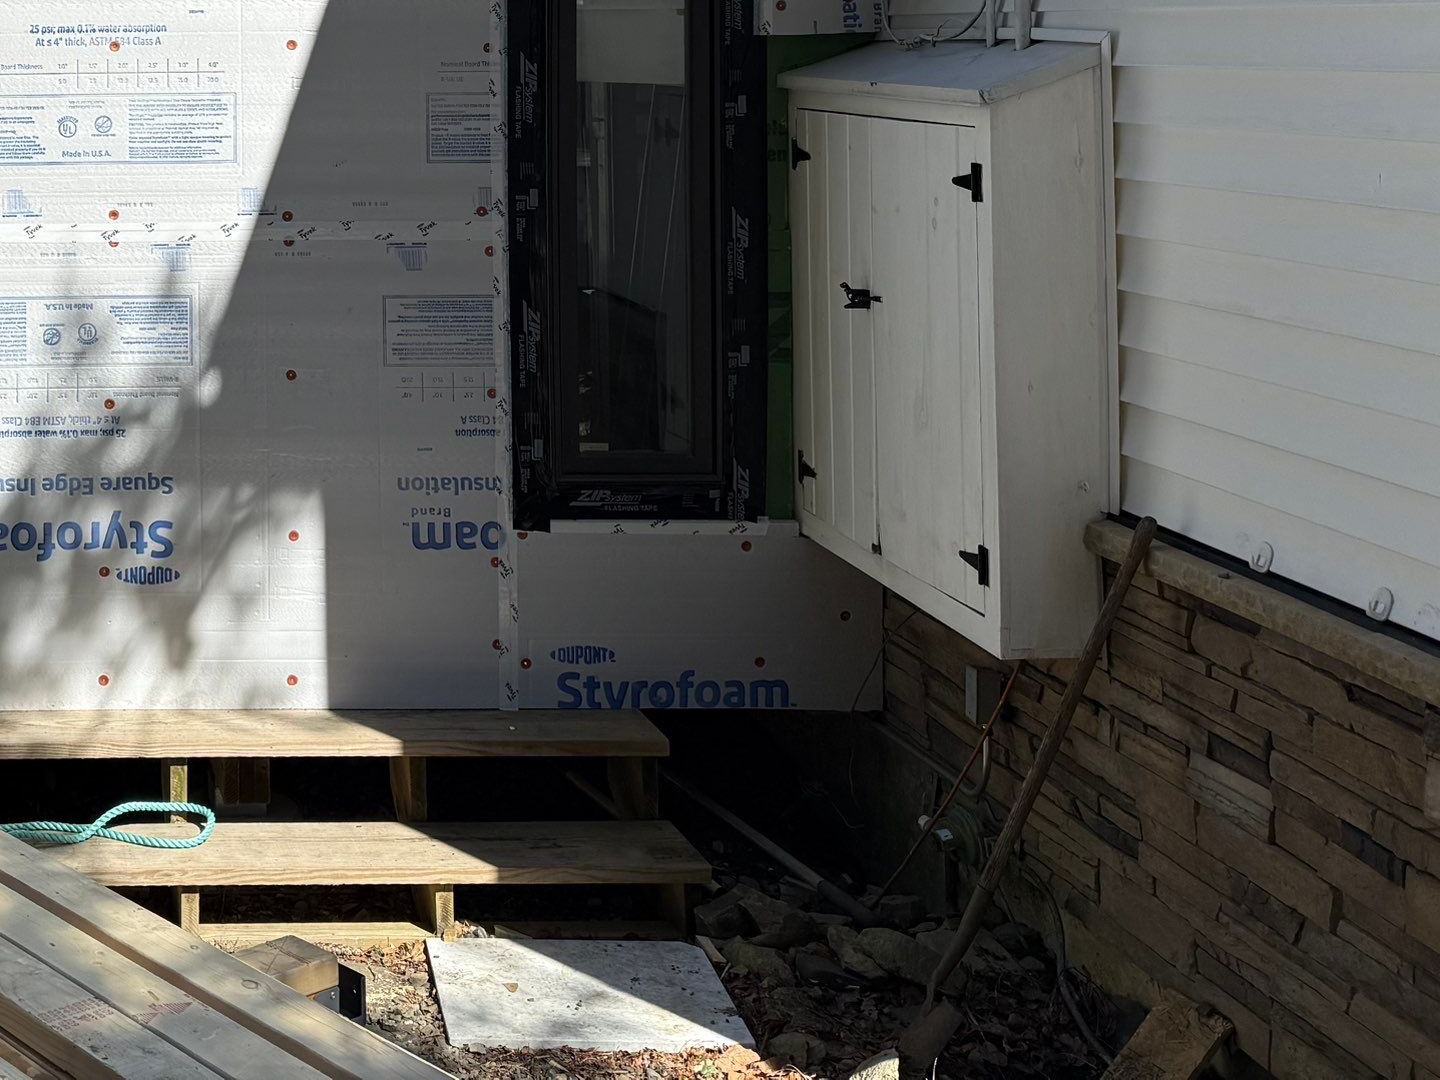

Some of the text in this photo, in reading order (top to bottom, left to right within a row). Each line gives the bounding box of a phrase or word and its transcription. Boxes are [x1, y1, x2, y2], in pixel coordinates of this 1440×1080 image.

[29, 25, 39, 34] 25
[57, 26, 75, 34] max
[77, 24, 96, 34] 0.1%
[98, 25, 120, 33] water
[122, 24, 167, 35] absorption
[525, 59, 538, 92] ZIP
[61, 150, 81, 158] Made
[45, 302, 64, 310] U.S.A.
[74, 303, 93, 311] Made
[1, 416, 22, 426] Class
[24, 416, 41, 426] E84
[43, 416, 67, 426] ASTM
[110, 416, 121, 426] At
[34, 429, 57, 438] water
[59, 429, 78, 438] 0.1%
[79, 429, 98, 437] max
[116, 429, 126, 438] 25
[42, 474, 93, 495] Edge
[100, 472, 174, 495] Square
[397, 476, 501, 495] nsulation
[578, 490, 611, 502] ZIP
[411, 507, 450, 517] Brand
[122, 566, 174, 585] DUPONT
[557, 646, 608, 665] DUPONT
[557, 669, 789, 710] Styrofoam
